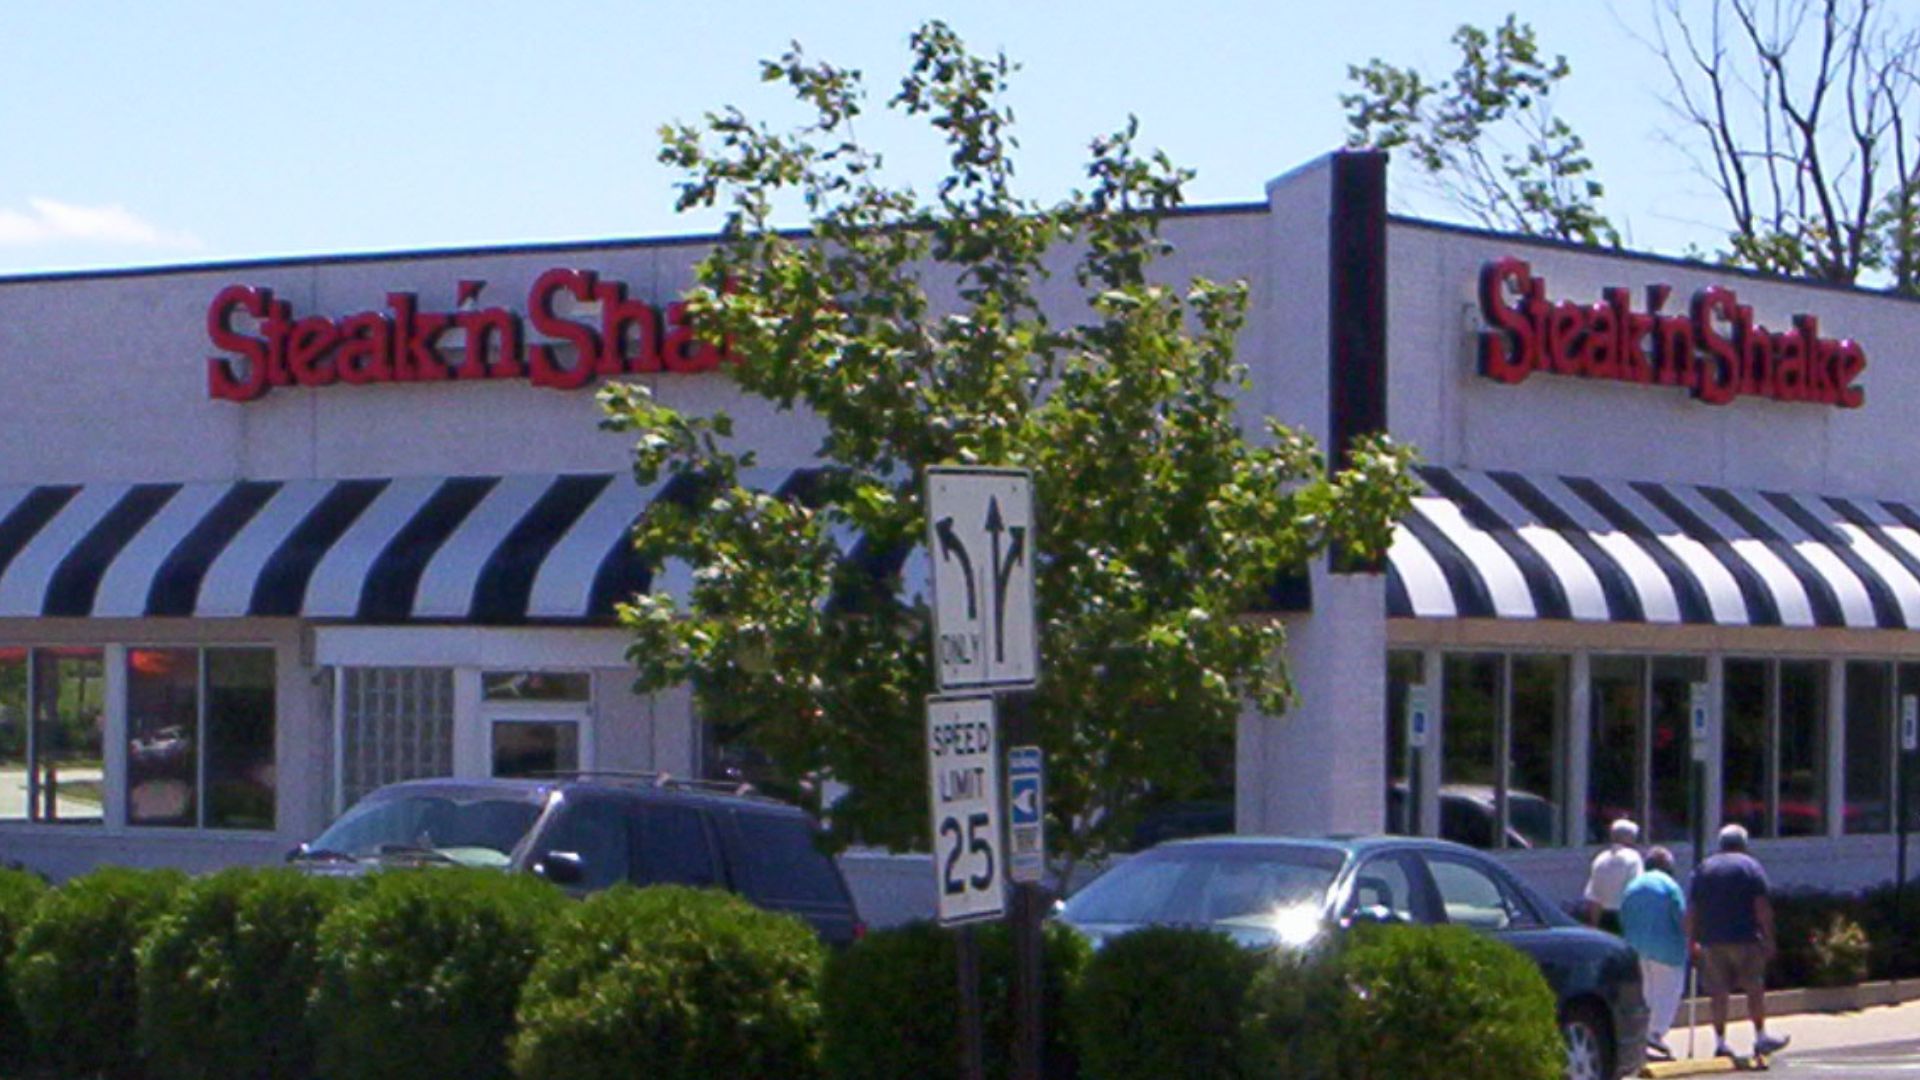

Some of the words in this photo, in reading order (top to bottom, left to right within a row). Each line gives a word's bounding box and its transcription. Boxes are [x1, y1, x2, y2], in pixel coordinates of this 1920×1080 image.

[529, 267, 753, 390] Sha
[1690, 285, 1866, 408] Shake
[941, 633, 981, 665] ONLY
[933, 721, 991, 756] SPEED
[940, 767, 984, 803] LIMIT
[940, 812, 994, 895] 25
